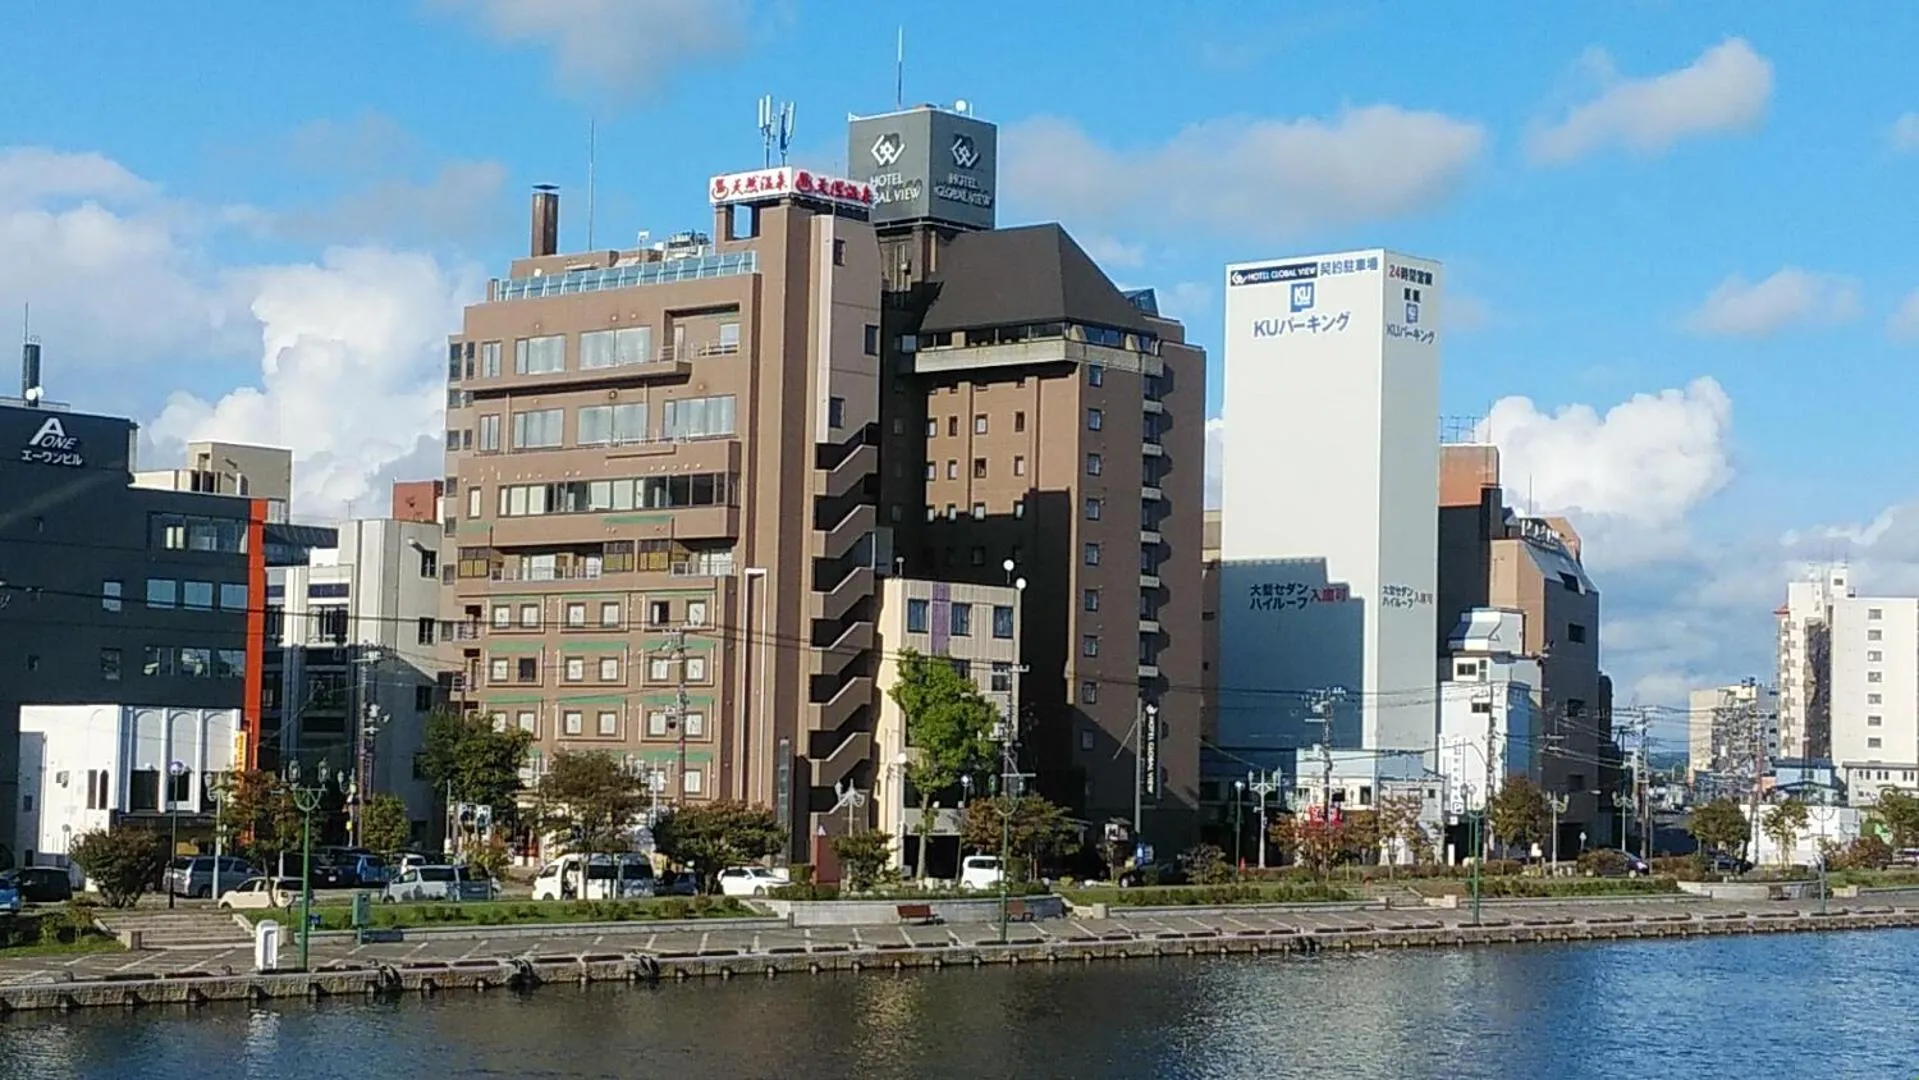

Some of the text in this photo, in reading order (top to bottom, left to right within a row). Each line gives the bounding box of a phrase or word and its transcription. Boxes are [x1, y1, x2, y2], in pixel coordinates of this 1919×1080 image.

[870, 173, 903, 188] HOTEL
[948, 173, 978, 188] HOTEL
[893, 187, 920, 201] VIEW
[1320, 256, 1378, 276] 契約駐車場
[1271, 269, 1297, 279] GLOBAL
[1254, 311, 1351, 337] KUパーキング
[21, 449, 83, 466] エーワンビル
[1250, 583, 1309, 596] 大型セダン
[1249, 596, 1309, 611] ハイルーフ
[1146, 715, 1155, 794] HOTEL GLOBAL VIEW
